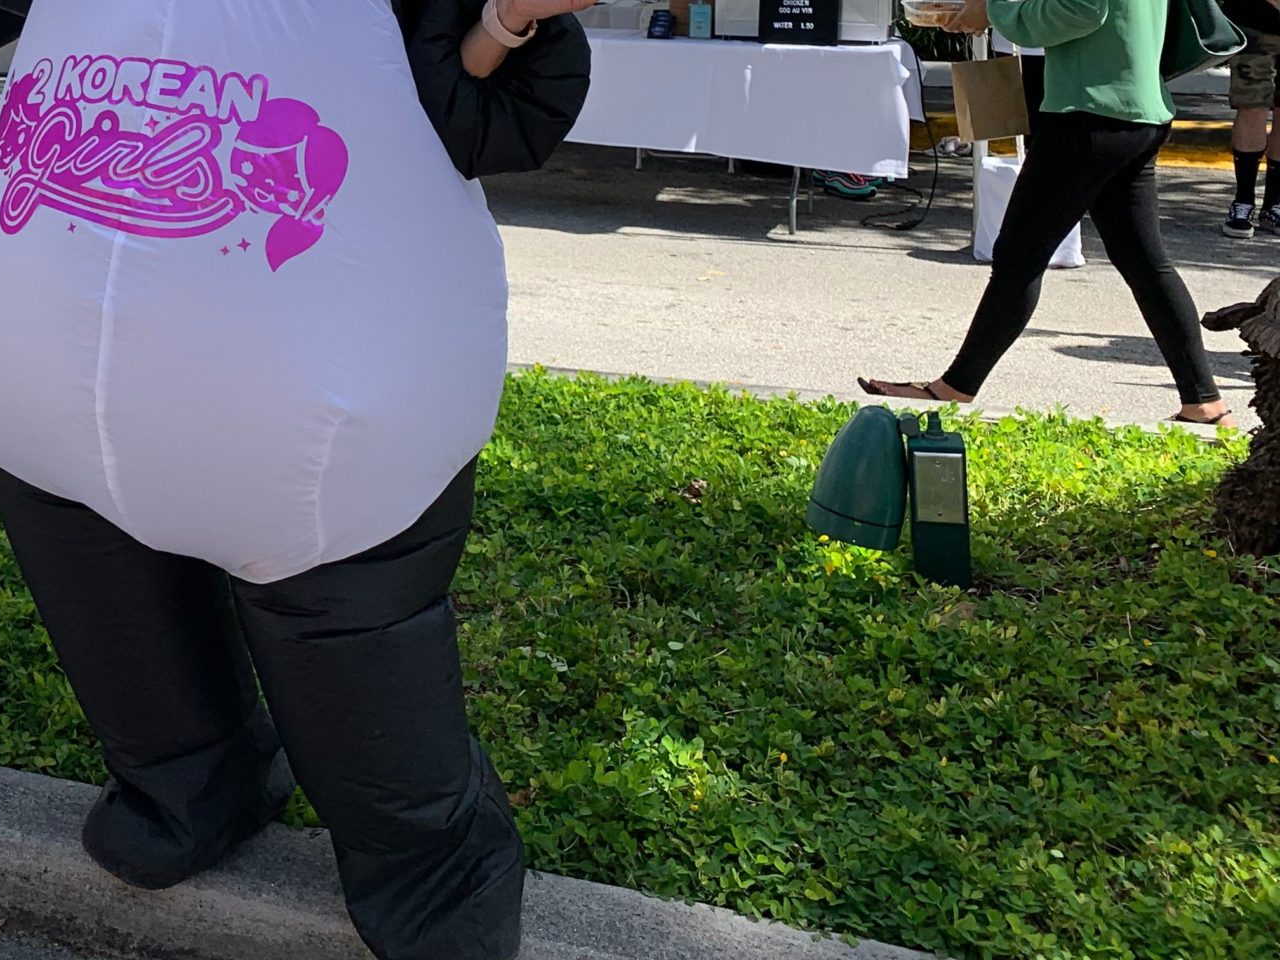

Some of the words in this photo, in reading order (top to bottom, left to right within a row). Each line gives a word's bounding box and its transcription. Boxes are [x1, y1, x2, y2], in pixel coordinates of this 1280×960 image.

[773, 21, 793, 29] WATER
[26, 57, 54, 107] 2
[55, 54, 269, 125] KOREAN
[1, 103, 245, 234] Girls
